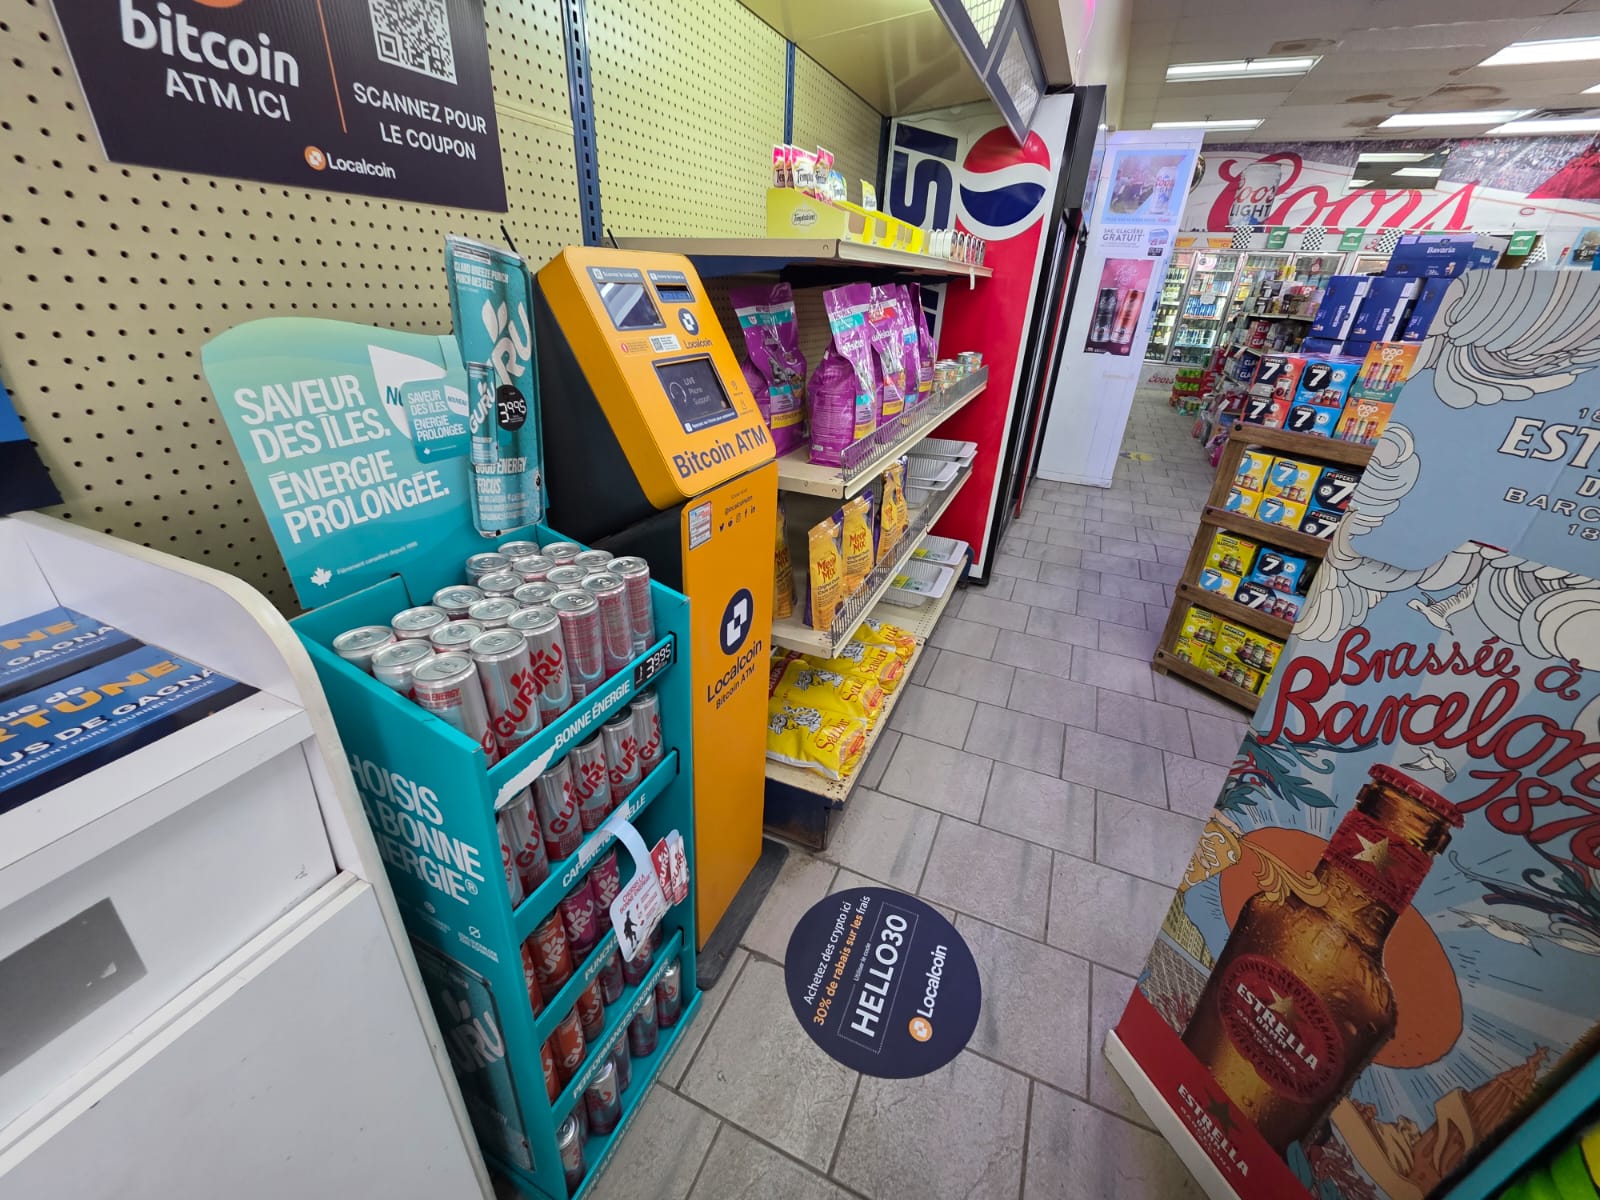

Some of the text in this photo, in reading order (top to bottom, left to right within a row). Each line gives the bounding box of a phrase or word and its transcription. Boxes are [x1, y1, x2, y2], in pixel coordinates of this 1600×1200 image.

[120, 0, 299, 87] bitcoin
[166, 68, 291, 122] ATM ICI
[353, 82, 487, 134] SCANNEZ POUR
[379, 122, 476, 160] LE COUPON
[326, 152, 396, 179] Localcoin
[1230, 204, 1271, 217] LIGHT
[1426, 246, 1456, 254] Bavaria
[684, 338, 713, 350] Localcoin
[1261, 362, 1281, 380] 7
[1309, 369, 1327, 387] 7
[233, 374, 366, 425] SAVEUR
[408, 389, 441, 403] SAVEUR
[410, 403, 428, 416] DES
[469, 382, 496, 434] GURU
[1249, 401, 1267, 419] 7
[249, 407, 392, 464] DES ÎLES.
[414, 415, 450, 431] ÉNERGIE
[1294, 410, 1312, 428] 7
[498, 457, 528, 473] ENERGY
[672, 425, 768, 479] Bitcoin ATM
[267, 449, 401, 511] ÉNERGIE
[477, 478, 501, 494] FOCUS
[1277, 465, 1294, 482] 7
[1327, 479, 1358, 504] 7
[282, 470, 450, 544] PROLONGÉE.
[1264, 500, 1280, 518] 7
[1316, 519, 1339, 538] 7
[1204, 572, 1218, 587] 7
[1262, 557, 1280, 571] 7
[1247, 590, 1269, 609] 7
[707, 639, 763, 703] Localcoin
[1329, 626, 1521, 686] Brassée
[45, 686, 87, 704] de
[715, 663, 755, 710] Bitcoin ATM
[1534, 658, 1583, 700] à
[54, 716, 109, 741] DE
[554, 680, 630, 750] BONNE ÉNERGIE
[350, 753, 444, 826] HOISIS
[376, 799, 485, 882] BONNE
[803, 901, 852, 1006] Achetez des crypto ici
[813, 895, 871, 1026] 30% de rabais sur les frais
[851, 914, 908, 1038] HELLO30
[917, 944, 948, 1019] Localcoin
[1236, 982, 1319, 1070] ESTRELLA
[1236, 1009, 1297, 1073] BARCELONA
[1255, 1015, 1288, 1049] DAMM
[1178, 1083, 1249, 1177] ESTRELLA
